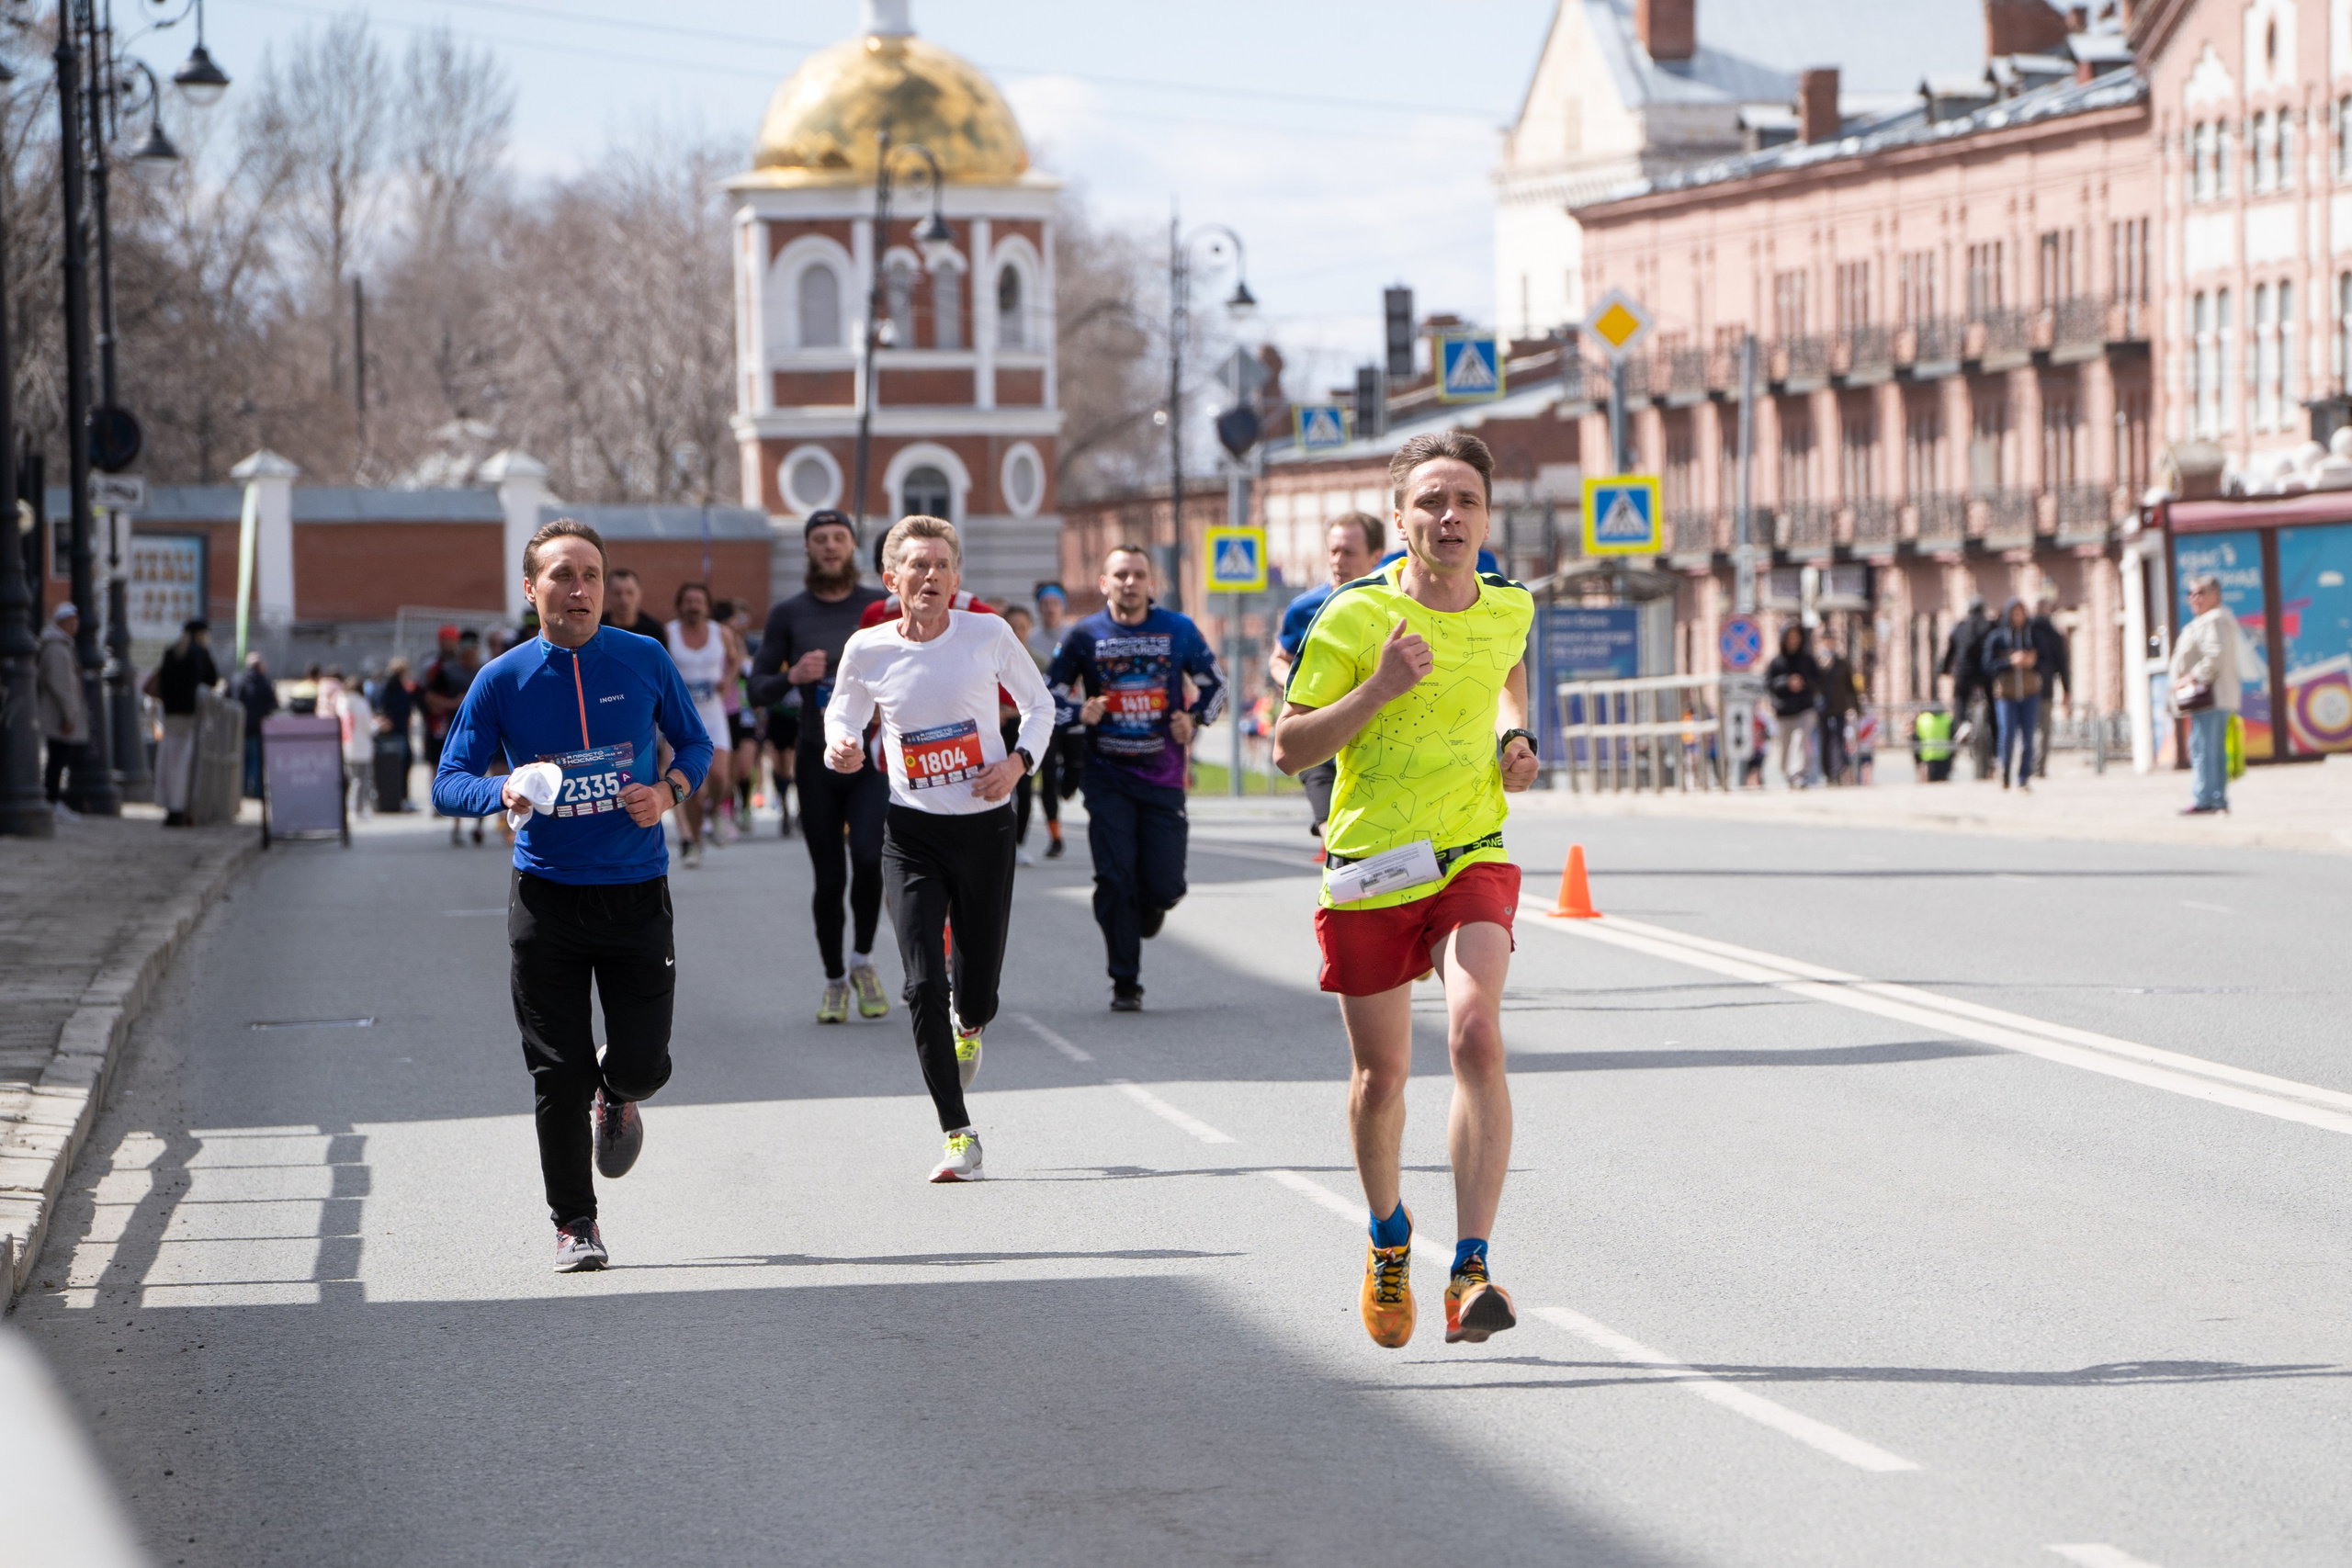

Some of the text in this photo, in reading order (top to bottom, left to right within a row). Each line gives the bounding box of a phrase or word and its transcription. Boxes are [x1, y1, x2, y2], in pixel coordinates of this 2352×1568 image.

[599, 694, 625, 704] INOVIX
[1120, 694, 1150, 711] 1411
[567, 755, 605, 764] КОСМОС
[572, 750, 605, 760] ПРОСТО
[919, 747, 967, 774] 1804
[563, 772, 620, 802] 2335
